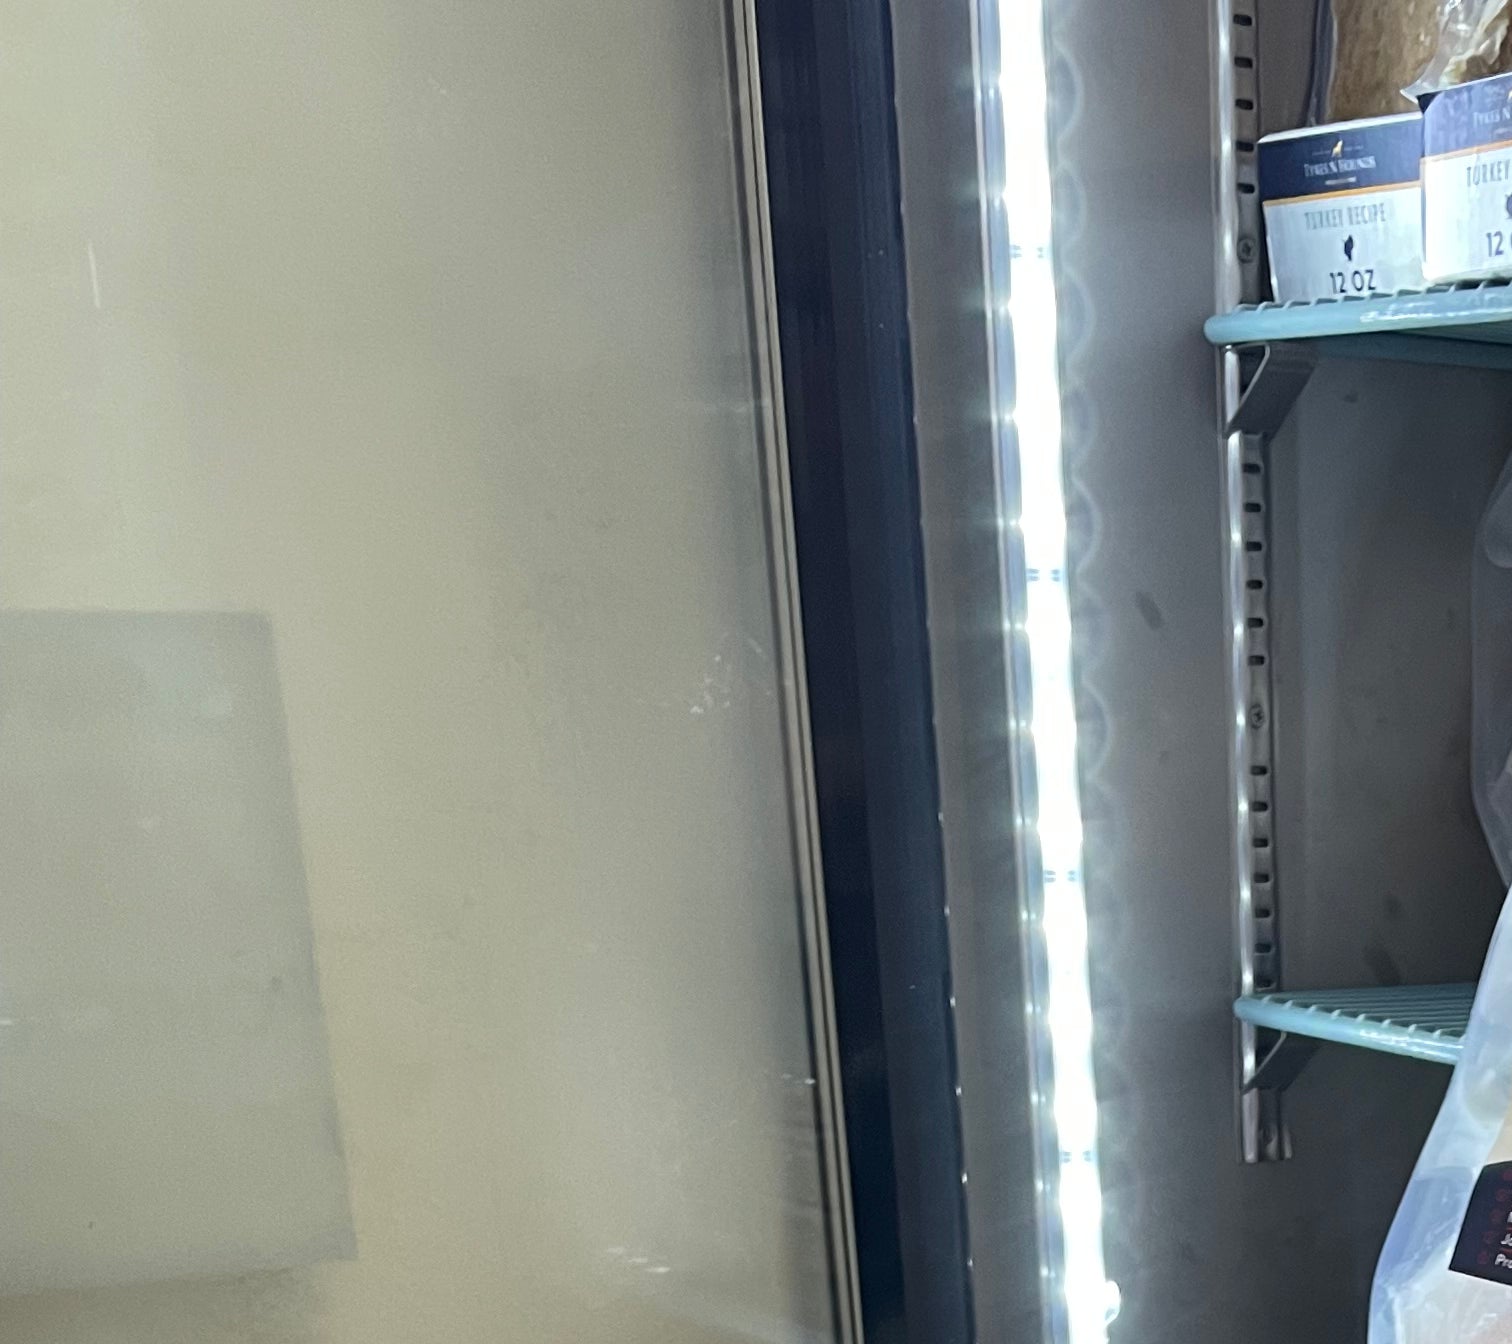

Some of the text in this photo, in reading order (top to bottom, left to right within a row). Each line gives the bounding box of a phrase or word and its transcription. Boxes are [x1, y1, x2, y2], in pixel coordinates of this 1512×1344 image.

[1466, 158, 1511, 188] TURKEY
[1346, 202, 1387, 227] RECIPE
[1486, 231, 1505, 258] 12
[1330, 269, 1376, 295] 12 OZ
